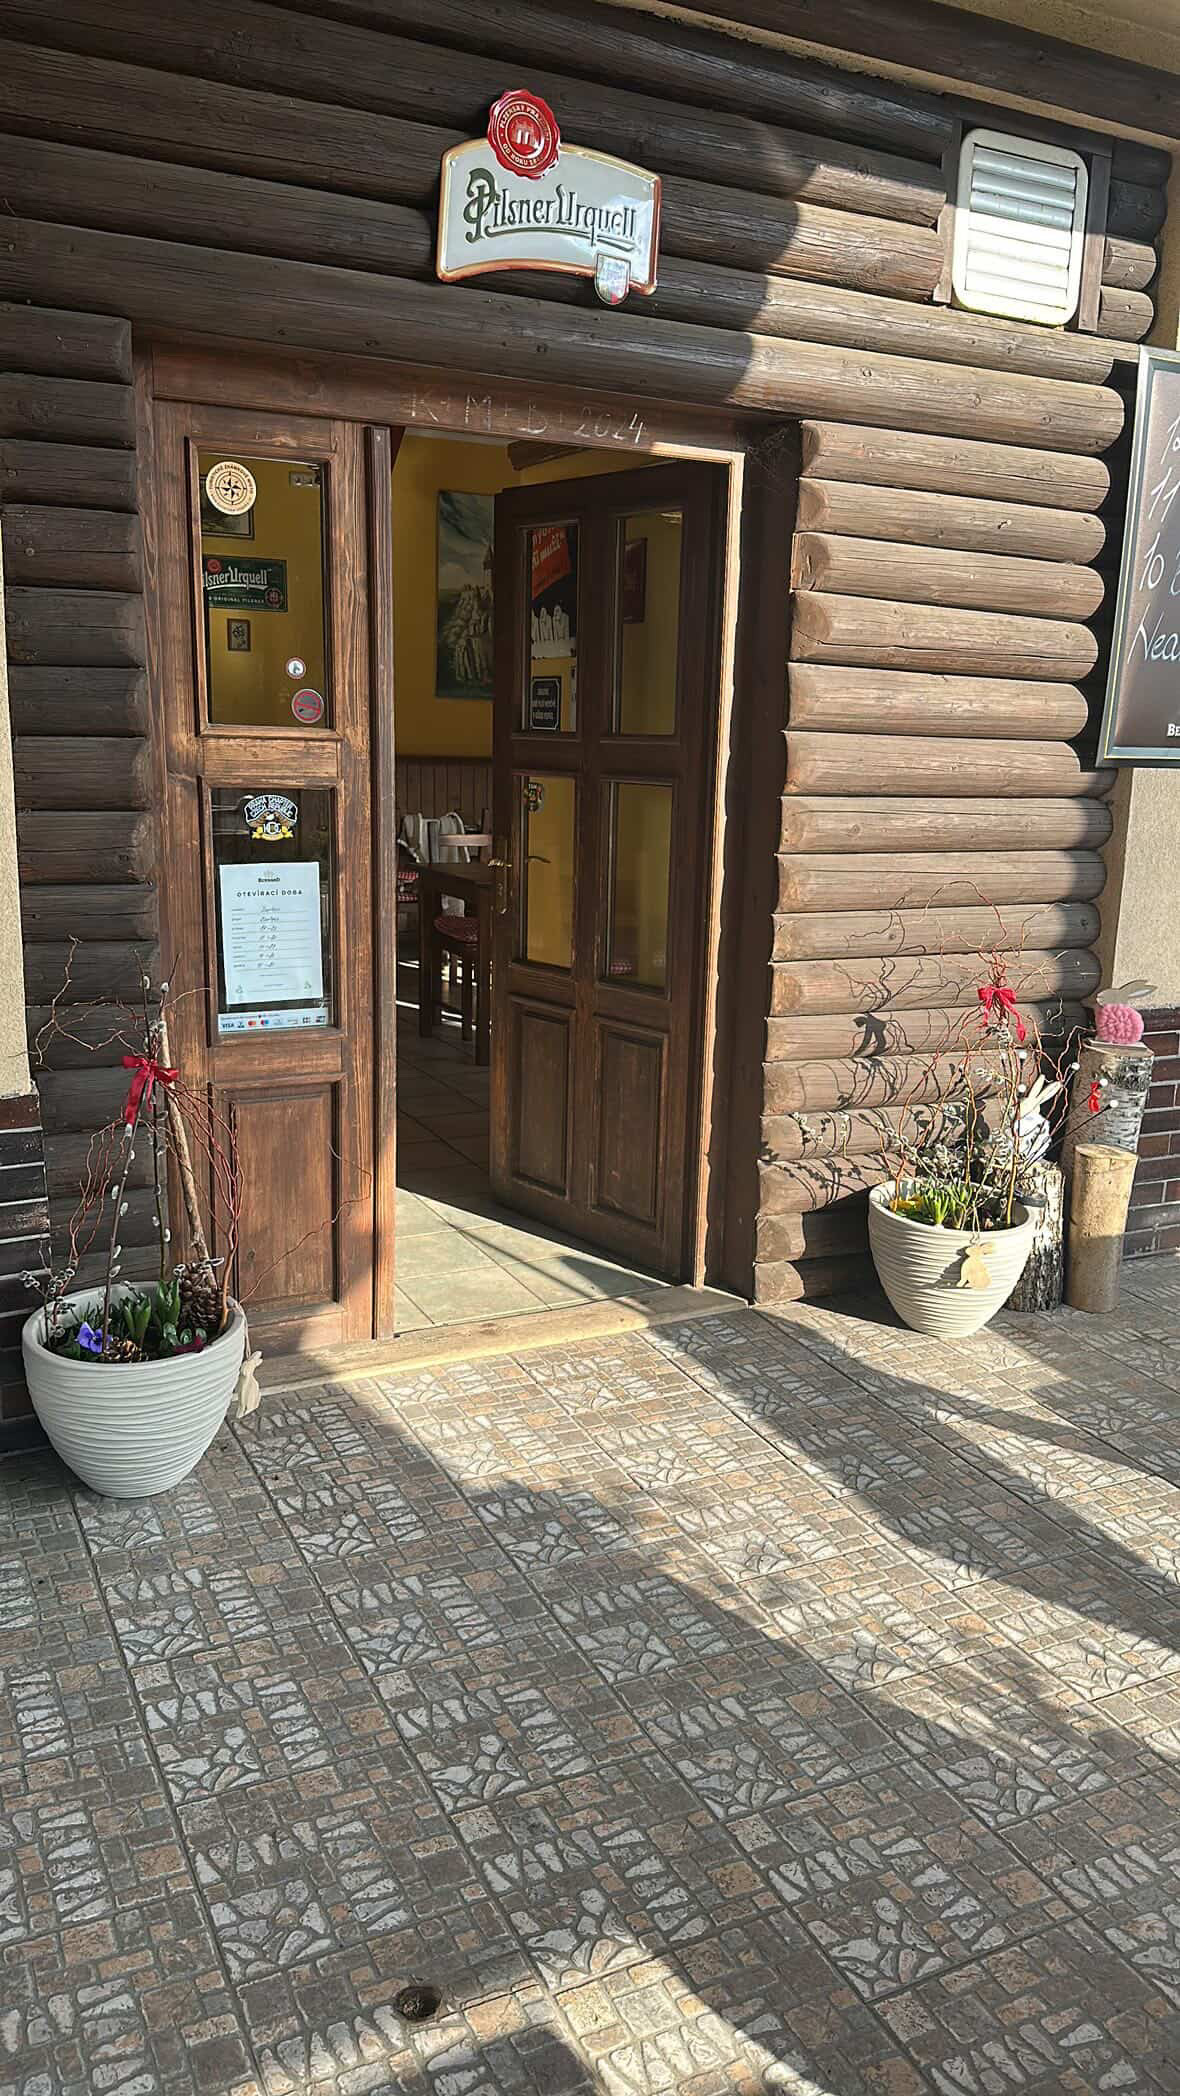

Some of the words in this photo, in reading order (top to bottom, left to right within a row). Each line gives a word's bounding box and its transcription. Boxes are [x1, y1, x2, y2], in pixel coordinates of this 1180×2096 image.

[463, 167, 555, 244] Pilsner
[555, 183, 637, 247] Urquell
[464, 393, 493, 432] M
[573, 405, 648, 445] 2024
[228, 565, 267, 591] Urquell
[236, 889, 279, 898] OTEVÍRACÍ
